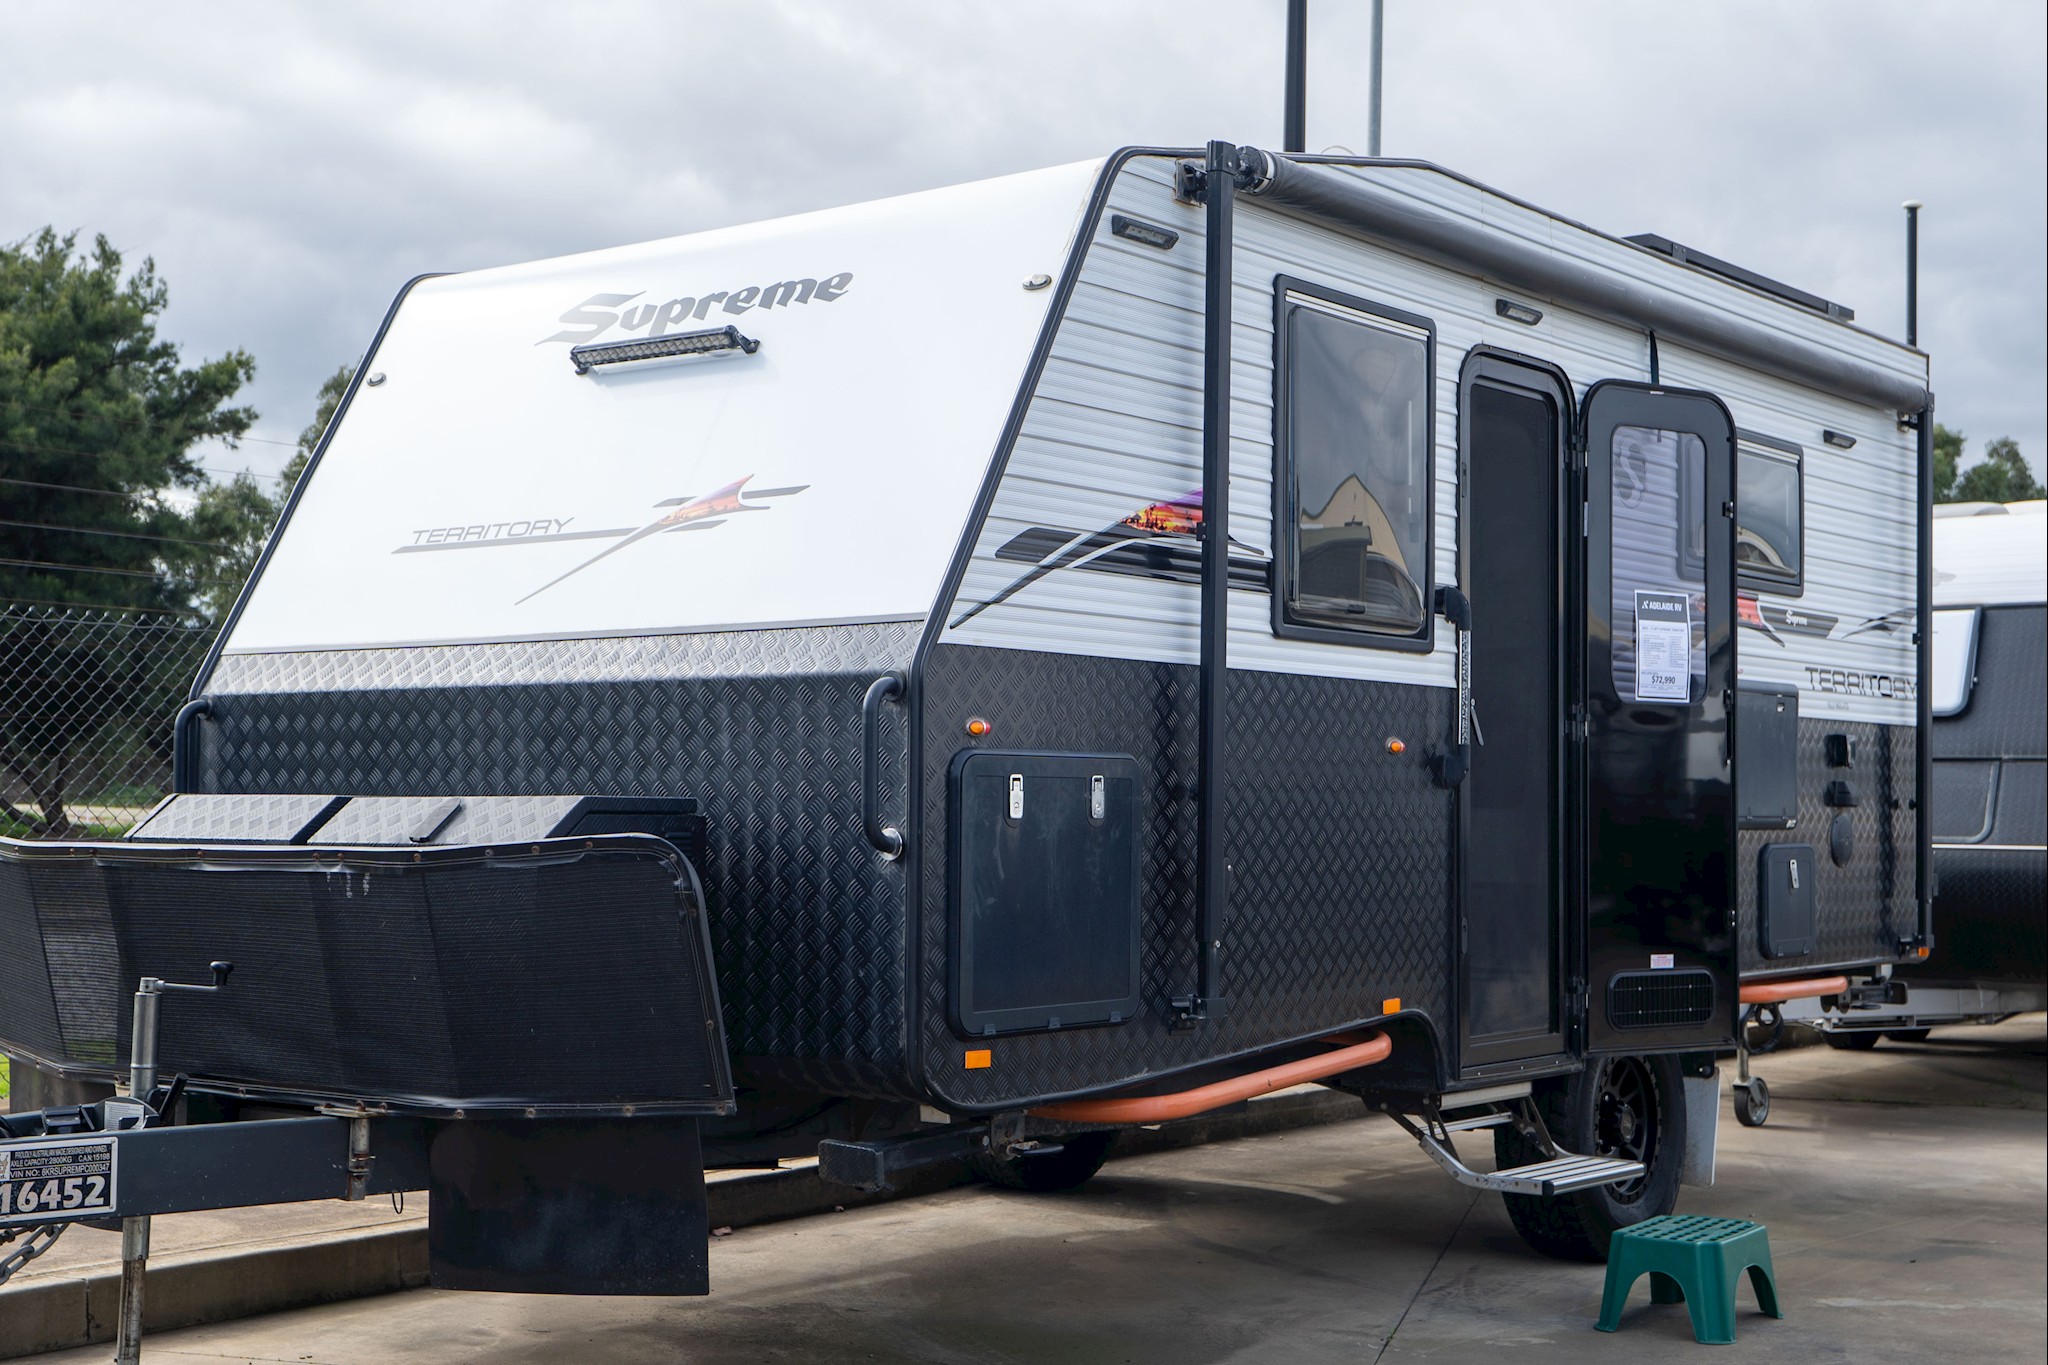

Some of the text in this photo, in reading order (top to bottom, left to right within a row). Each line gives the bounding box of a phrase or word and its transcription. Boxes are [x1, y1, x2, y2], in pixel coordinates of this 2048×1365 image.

[534, 272, 854, 346] Supreme
[413, 517, 575, 545] TERRITORY
[1649, 601, 1683, 612] ADELAIDE RV
[1651, 674, 1676, 685] $72,990
[1805, 666, 1917, 701] TERRITORY
[11, 1159, 23, 1168] AXLE
[10, 1169, 23, 1178] VIN
